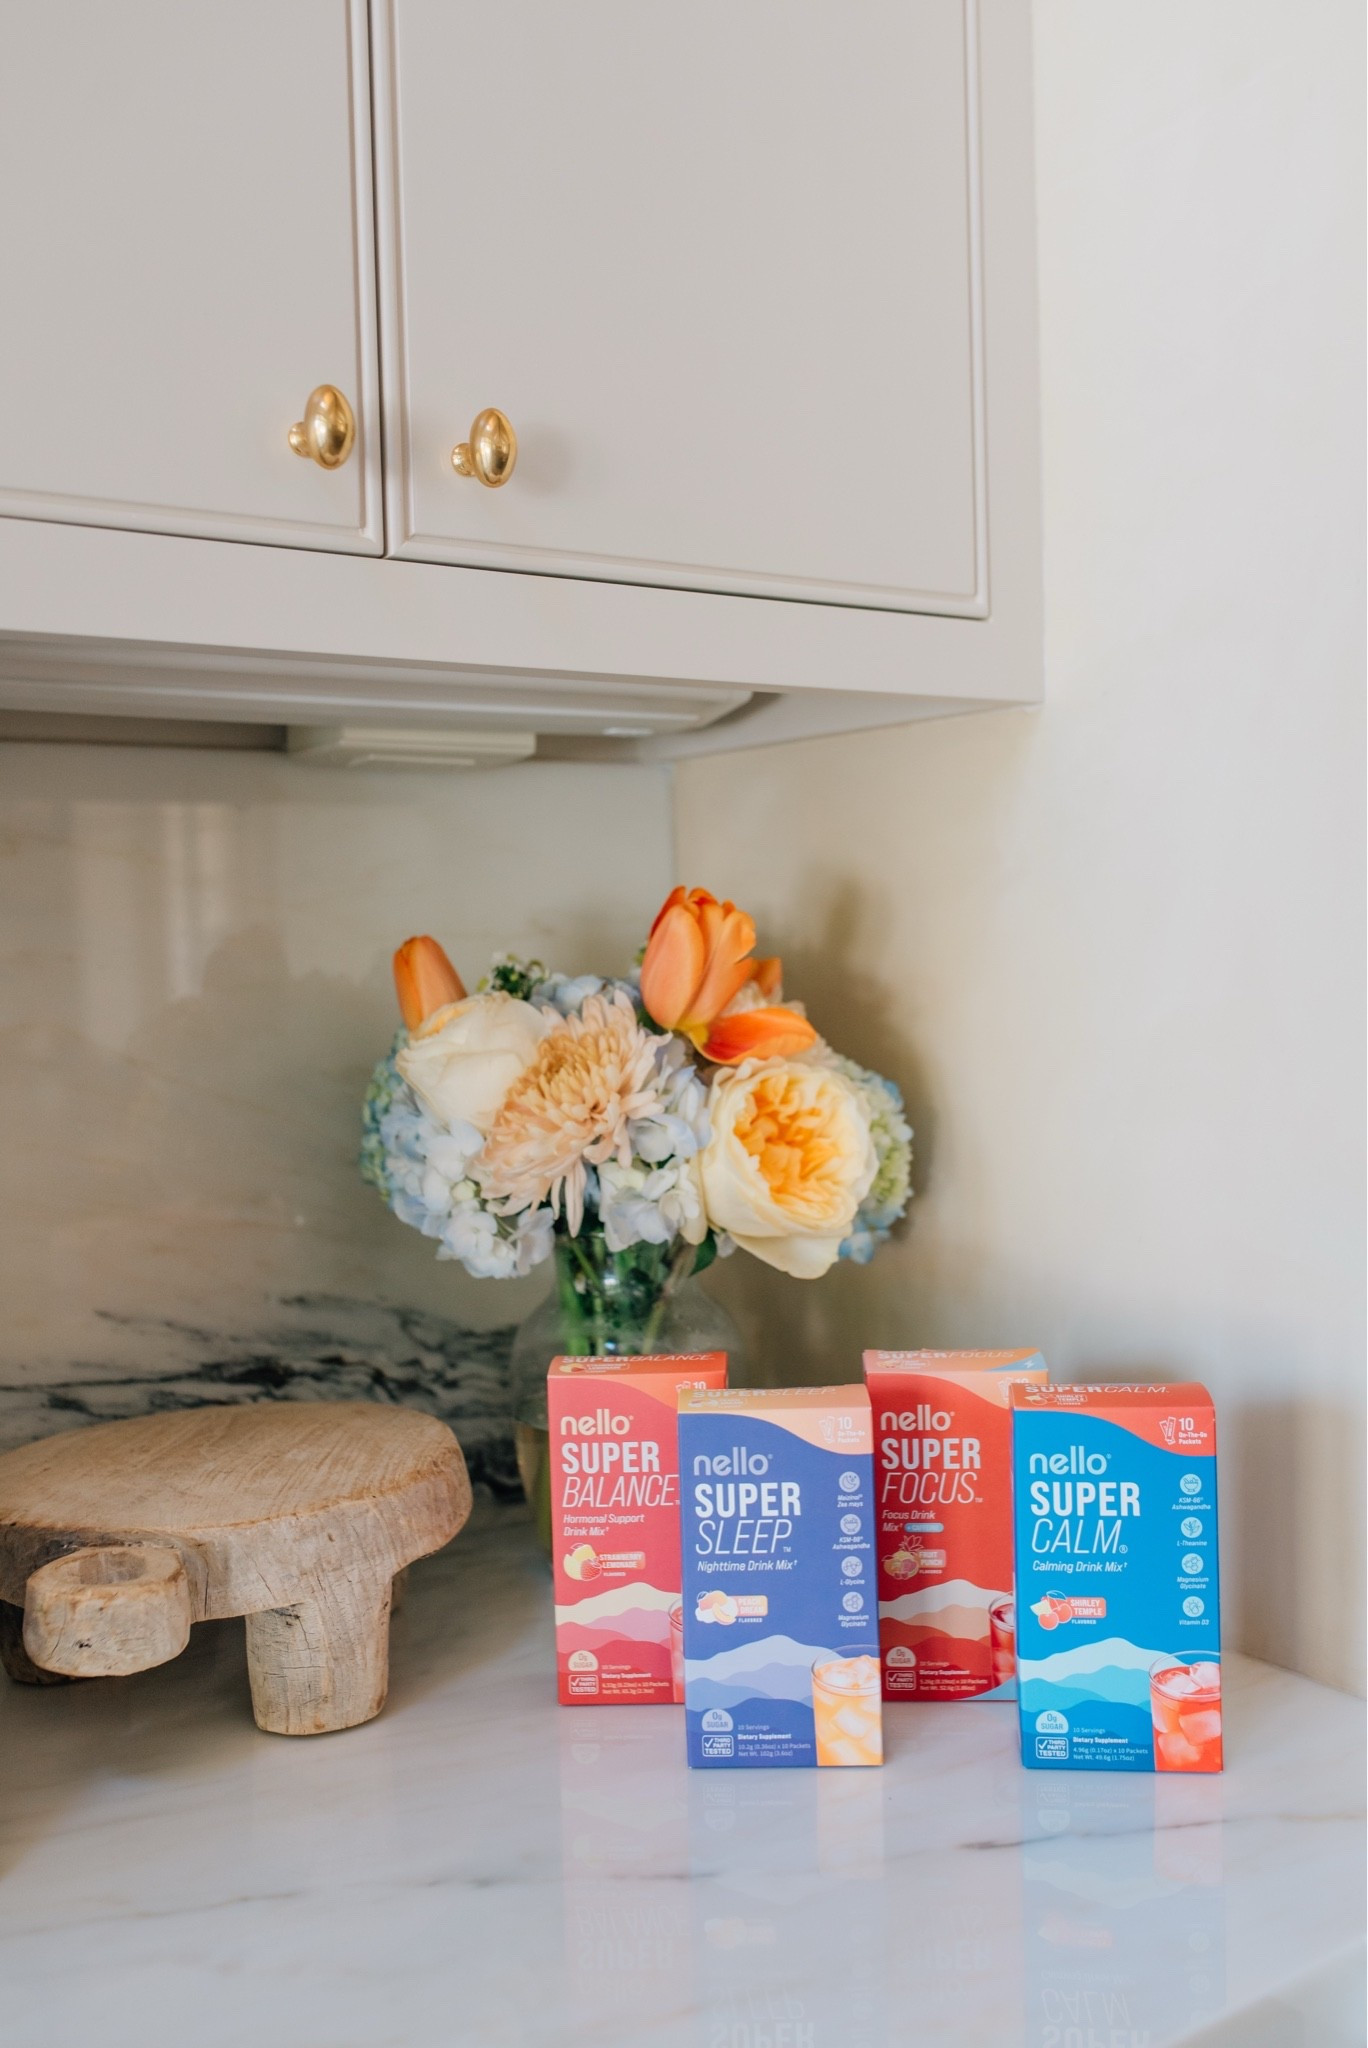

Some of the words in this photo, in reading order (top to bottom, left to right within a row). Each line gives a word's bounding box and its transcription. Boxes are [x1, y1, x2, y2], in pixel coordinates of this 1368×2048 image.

[838, 1416, 852, 1430] 10
[1178, 1417, 1194, 1431] 10
[561, 1441, 660, 1474] SUPER
[881, 1437, 981, 1470] SUPER
[694, 1481, 801, 1518] SUPER
[1030, 1480, 1141, 1517] SUPER
[563, 1513, 607, 1524] Hormonal
[608, 1513, 645, 1525] Support
[882, 1510, 909, 1520] Focus
[910, 1510, 936, 1520] Drink
[563, 1527, 587, 1536] Drink
[697, 1560, 746, 1574] Nighttime
[748, 1560, 774, 1571] Drink
[1032, 1560, 1074, 1574] Calming
[1076, 1561, 1100, 1572] Drink
[1070, 1599, 1100, 1607] SHIRLEY
[1074, 1608, 1103, 1616] TEMPLE
[1046, 1714, 1057, 1723] 0g
